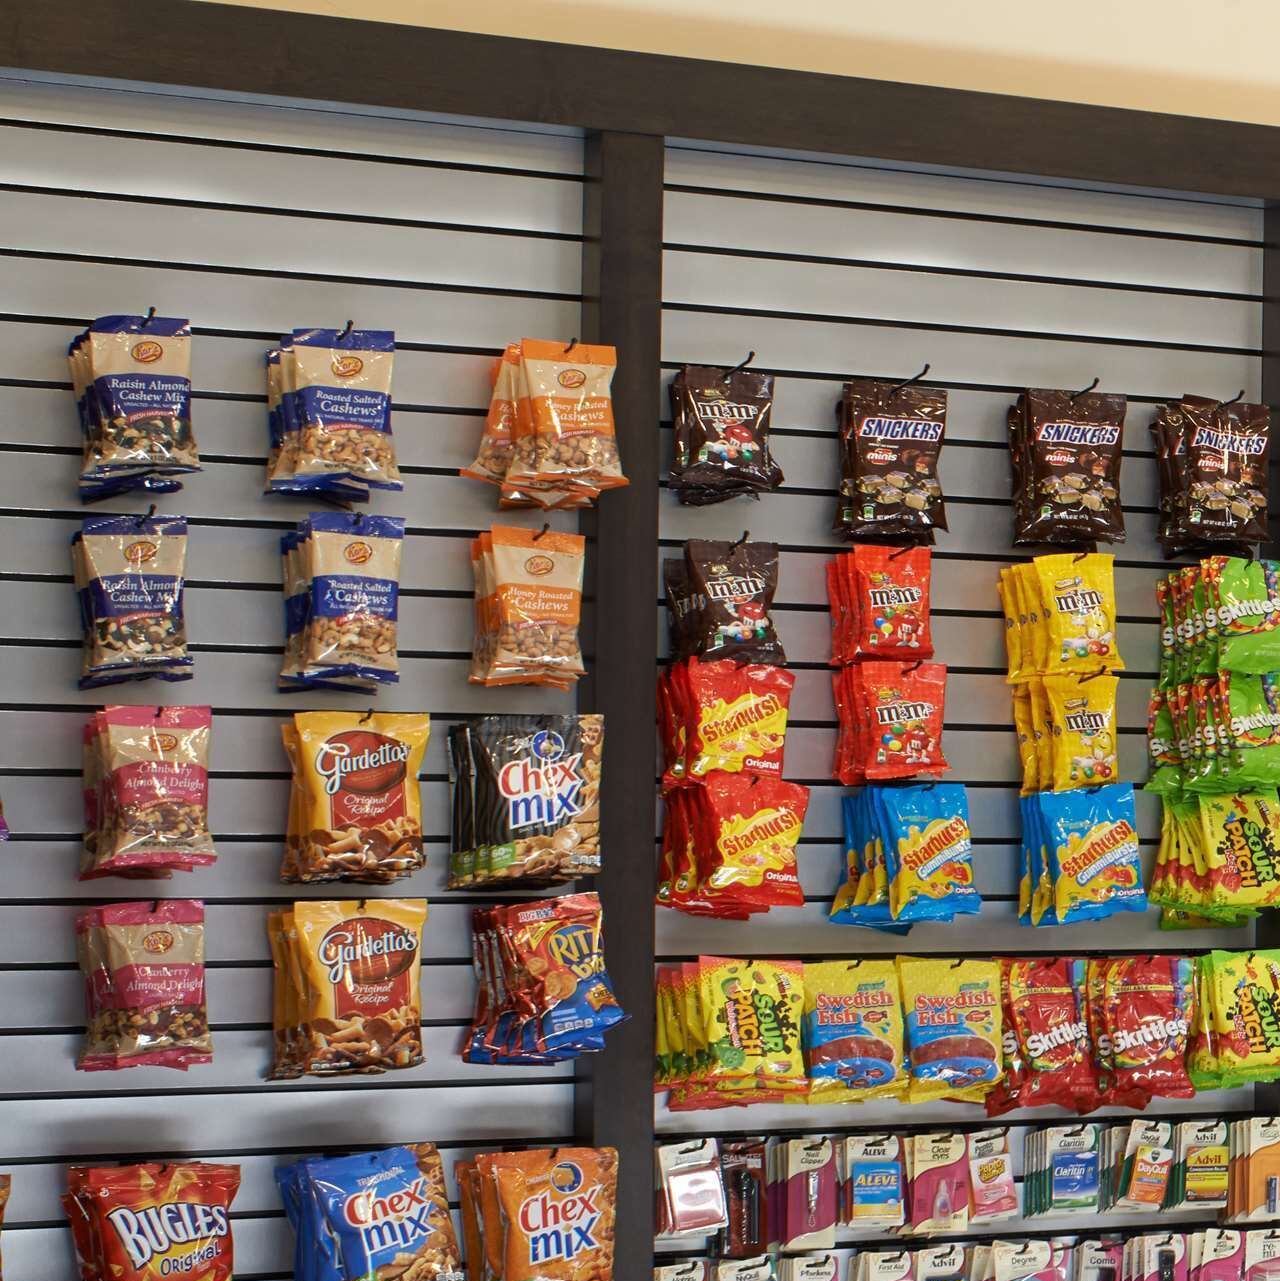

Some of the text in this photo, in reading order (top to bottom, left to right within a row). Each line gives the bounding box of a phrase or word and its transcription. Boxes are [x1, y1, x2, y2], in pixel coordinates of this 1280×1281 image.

[111, 378, 146, 390] Raisin
[119, 390, 186, 403] Cashew Mix
[316, 390, 381, 404] Roasted Salted
[321, 400, 378, 416] Cashews
[859, 418, 944, 442] SNICKERS
[1038, 423, 1120, 445] SNICKERS
[330, 579, 392, 592] Roasted Salted
[110, 590, 154, 603] Cashew
[539, 588, 574, 600] Roasted
[315, 740, 412, 795] Gardetto's
[745, 757, 779, 770] Original
[510, 784, 583, 830] mix
[721, 810, 799, 857] Starburst
[318, 928, 419, 986] Gardetto's
[816, 990, 895, 1010] Swedish
[914, 989, 996, 1010] Swedish
[816, 1008, 858, 1027] Fish
[915, 1008, 959, 1027] Fish
[1026, 1019, 1089, 1058] Skittles
[1113, 1018, 1190, 1055] Skittles
[1058, 1139, 1086, 1149] Claritin
[1194, 1133, 1217, 1143] Advil
[861, 1147, 888, 1157] ALEVE
[931, 1145, 952, 1156] Clear
[931, 1152, 949, 1162] eyes
[801, 1156, 825, 1166] Clipper
[1194, 1154, 1222, 1166] Advil
[1055, 1166, 1085, 1179] Claritin
[1137, 1163, 1169, 1175] DayQuil
[857, 1173, 898, 1187] ALEVE
[343, 1179, 426, 1229] Chex
[520, 1184, 603, 1234] Chex
[362, 1203, 438, 1256] mix
[109, 1202, 228, 1272] BUGLES
[529, 1211, 602, 1266] mix
[878, 1263, 905, 1272] First Aid
[930, 1258, 956, 1268] Advil
[1011, 1256, 1038, 1266] Degree
[1090, 1255, 1116, 1266] Comb
